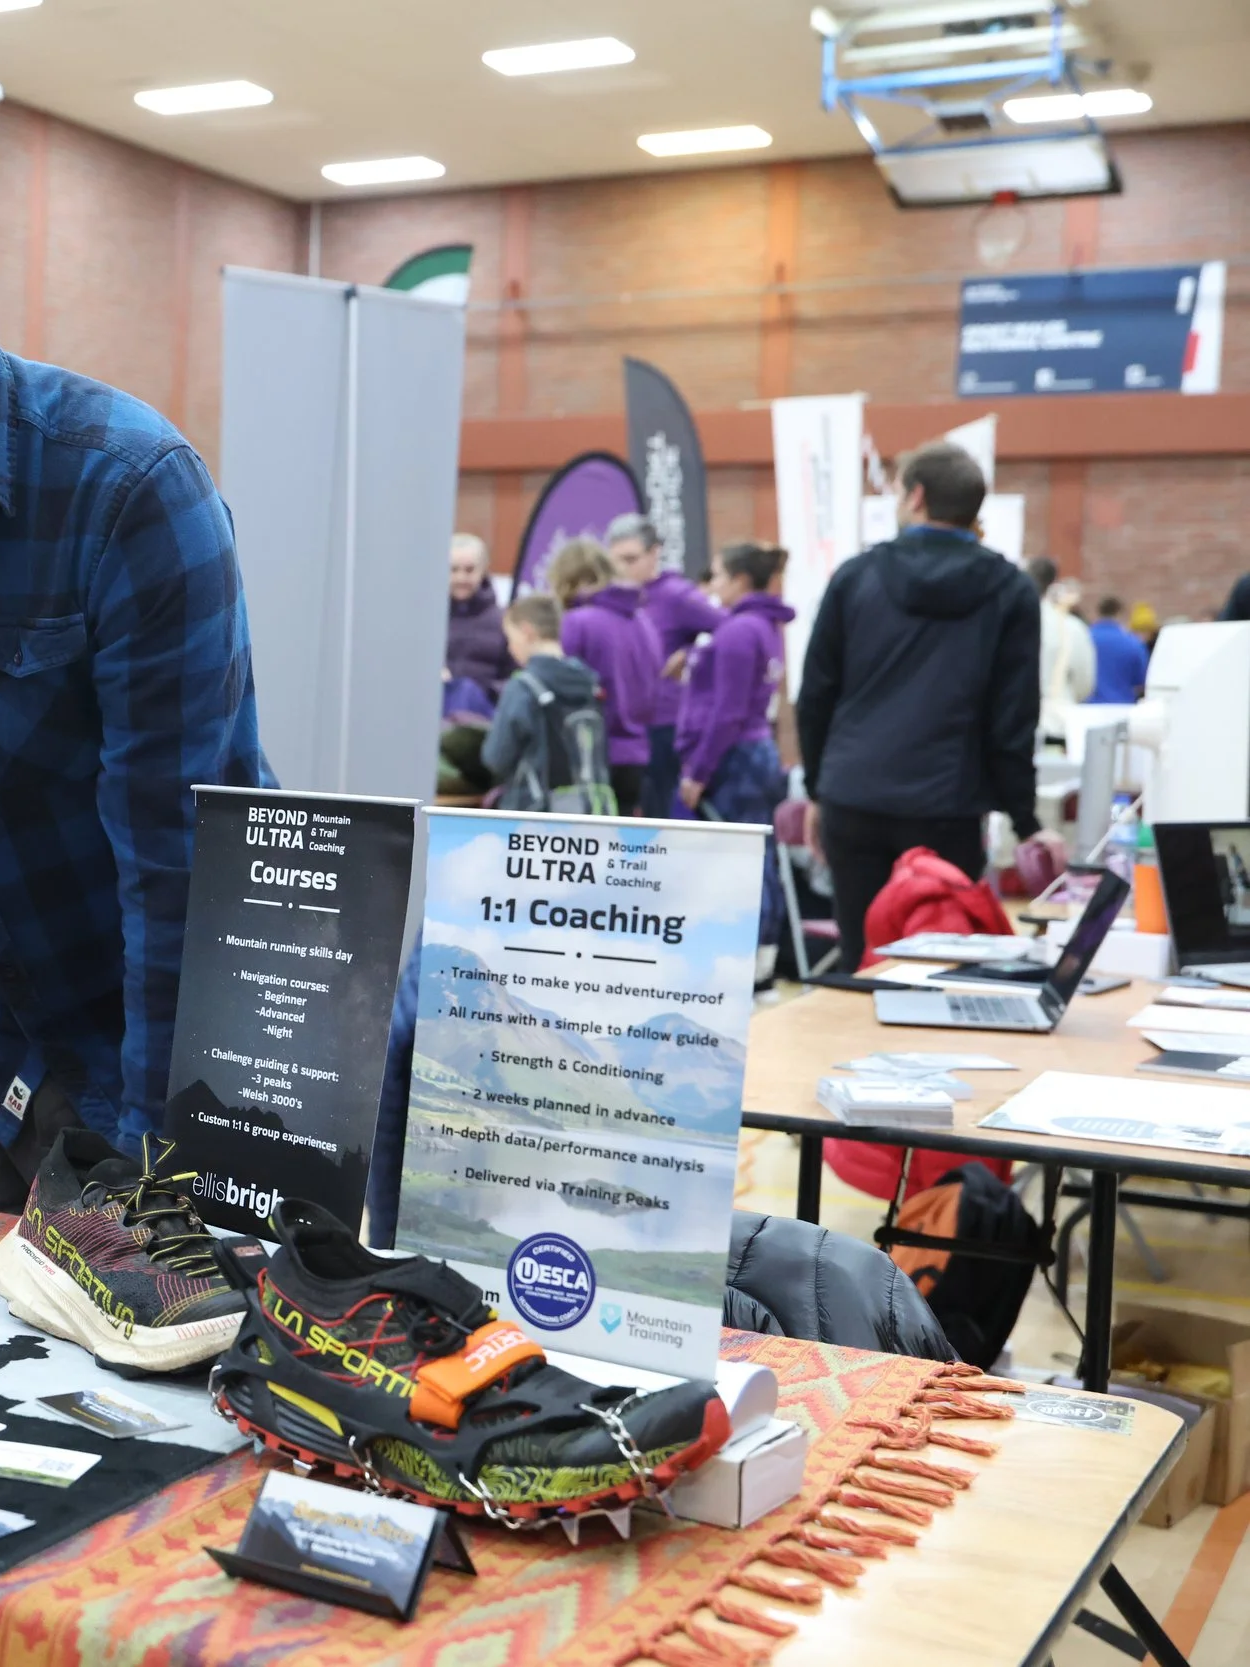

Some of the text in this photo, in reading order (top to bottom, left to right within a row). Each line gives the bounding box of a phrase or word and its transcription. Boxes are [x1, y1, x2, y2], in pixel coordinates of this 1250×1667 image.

[248, 806, 351, 827] BEYOND Mountain
[246, 827, 337, 850] ULTRA & Trail
[309, 841, 346, 855] Coaching
[507, 833, 667, 857] BEYOND Mountain
[250, 860, 337, 891] Courses
[505, 857, 647, 885] ULTRA & Trail
[605, 875, 662, 892] Coaching
[480, 896, 685, 944] 1:1 Coaching
[226, 935, 353, 964] Mountain running skills day
[240, 969, 330, 993] Navigation courses:
[451, 966, 724, 1006] Training to make you adventureproof
[264, 990, 307, 1007] Beginner
[255, 1005, 305, 1024] -Advanced
[448, 1006, 719, 1050] All runs with a simple to follow guide
[262, 1023, 293, 1039] -Night
[211, 1047, 339, 1084] Challenge guiding & support:
[491, 1050, 665, 1085] Strength & Conditioning
[251, 1073, 292, 1092] -3 peaks
[237, 1087, 303, 1110] -Welsh 3000's
[472, 1088, 676, 1126] 2 weeks planned in advance
[198, 1111, 337, 1153] Custom 1:1 & group experiences
[440, 1123, 705, 1174] In-depth data/performance analysis
[192, 1172, 284, 1220] ellisbrigh
[464, 1168, 670, 1211] Delivered via Training Peaks
[515, 1256, 589, 1291] UESCA
[626, 1310, 692, 1333] Mountain
[627, 1324, 683, 1349] Training
[306, 1325, 417, 1398] SPORTI
